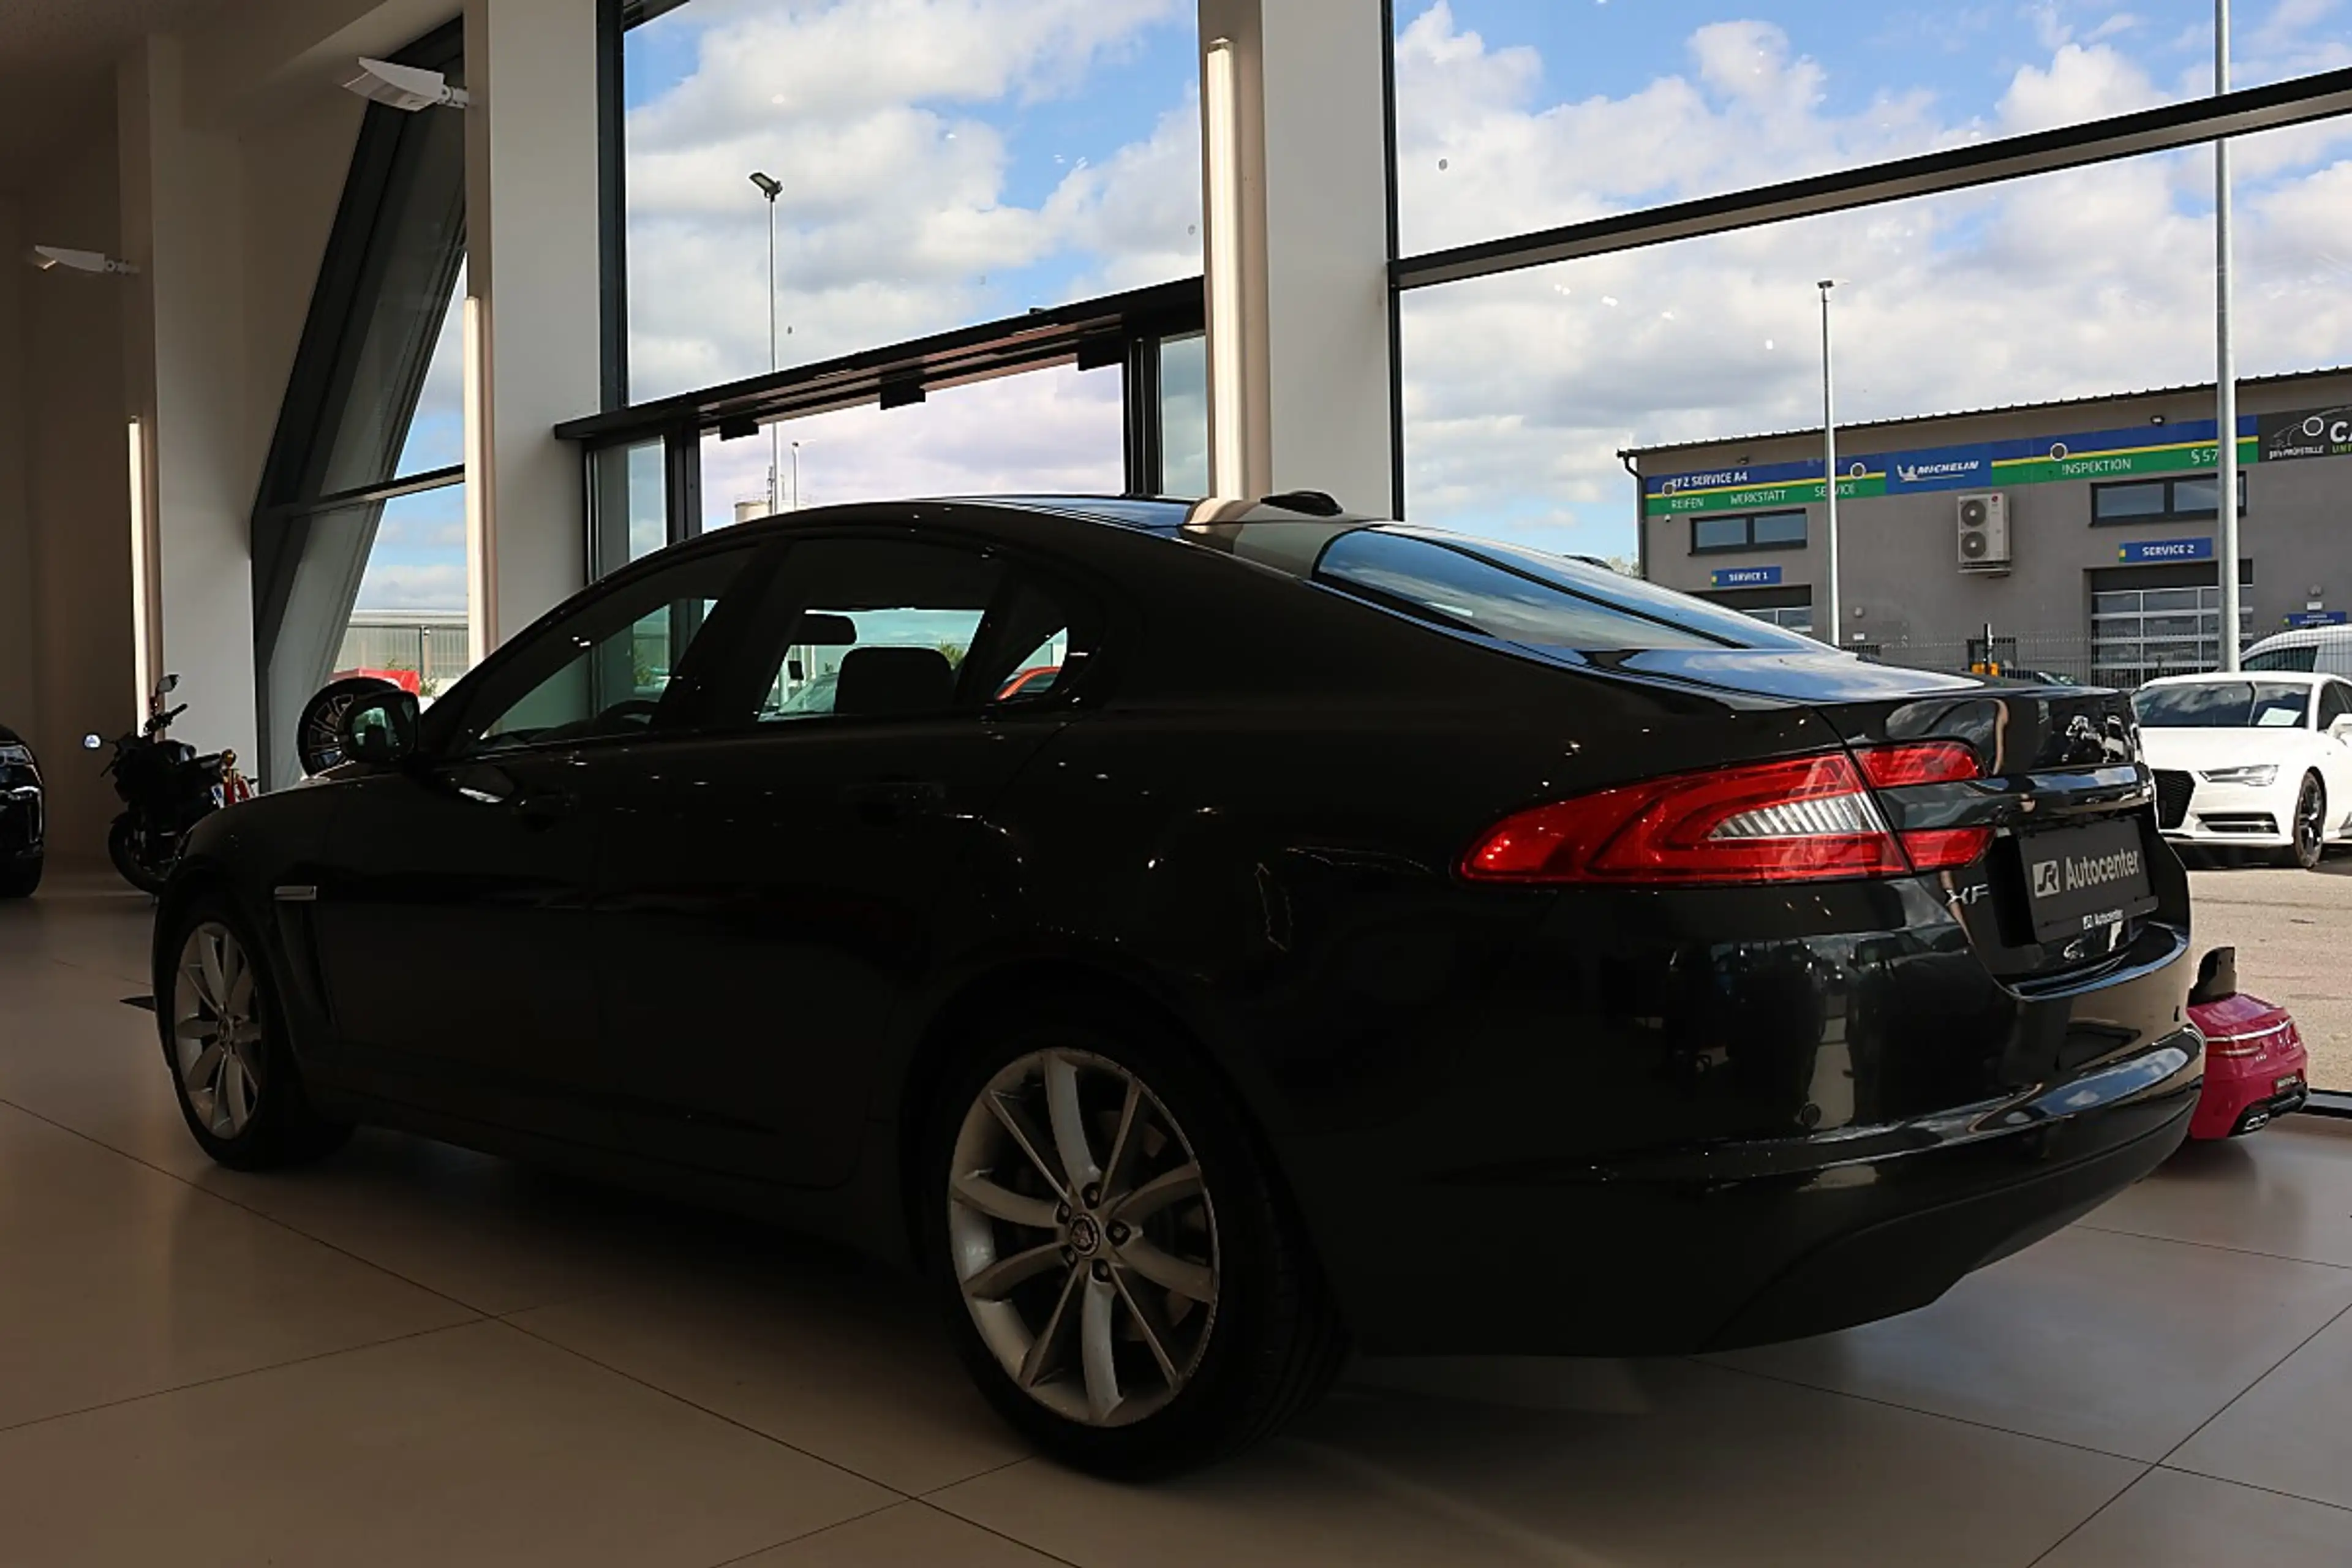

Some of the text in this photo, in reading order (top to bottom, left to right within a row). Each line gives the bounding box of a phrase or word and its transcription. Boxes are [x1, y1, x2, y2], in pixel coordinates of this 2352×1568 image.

[2330, 421, 2352, 442] C
[1917, 460, 1980, 475] MICHELIN
[2062, 458, 2132, 475] INSPEKTION
[1691, 472, 1732, 486] SERVICE
[1733, 470, 1747, 483] A4
[1671, 483, 1855, 510] REIFEN WERKSTATT SEVICE
[2142, 544, 2195, 557] SERVICE 2
[1728, 571, 1768, 581] SERVICE 1
[2065, 847, 2139, 891] Autocenter
[1945, 883, 1989, 907] XF
